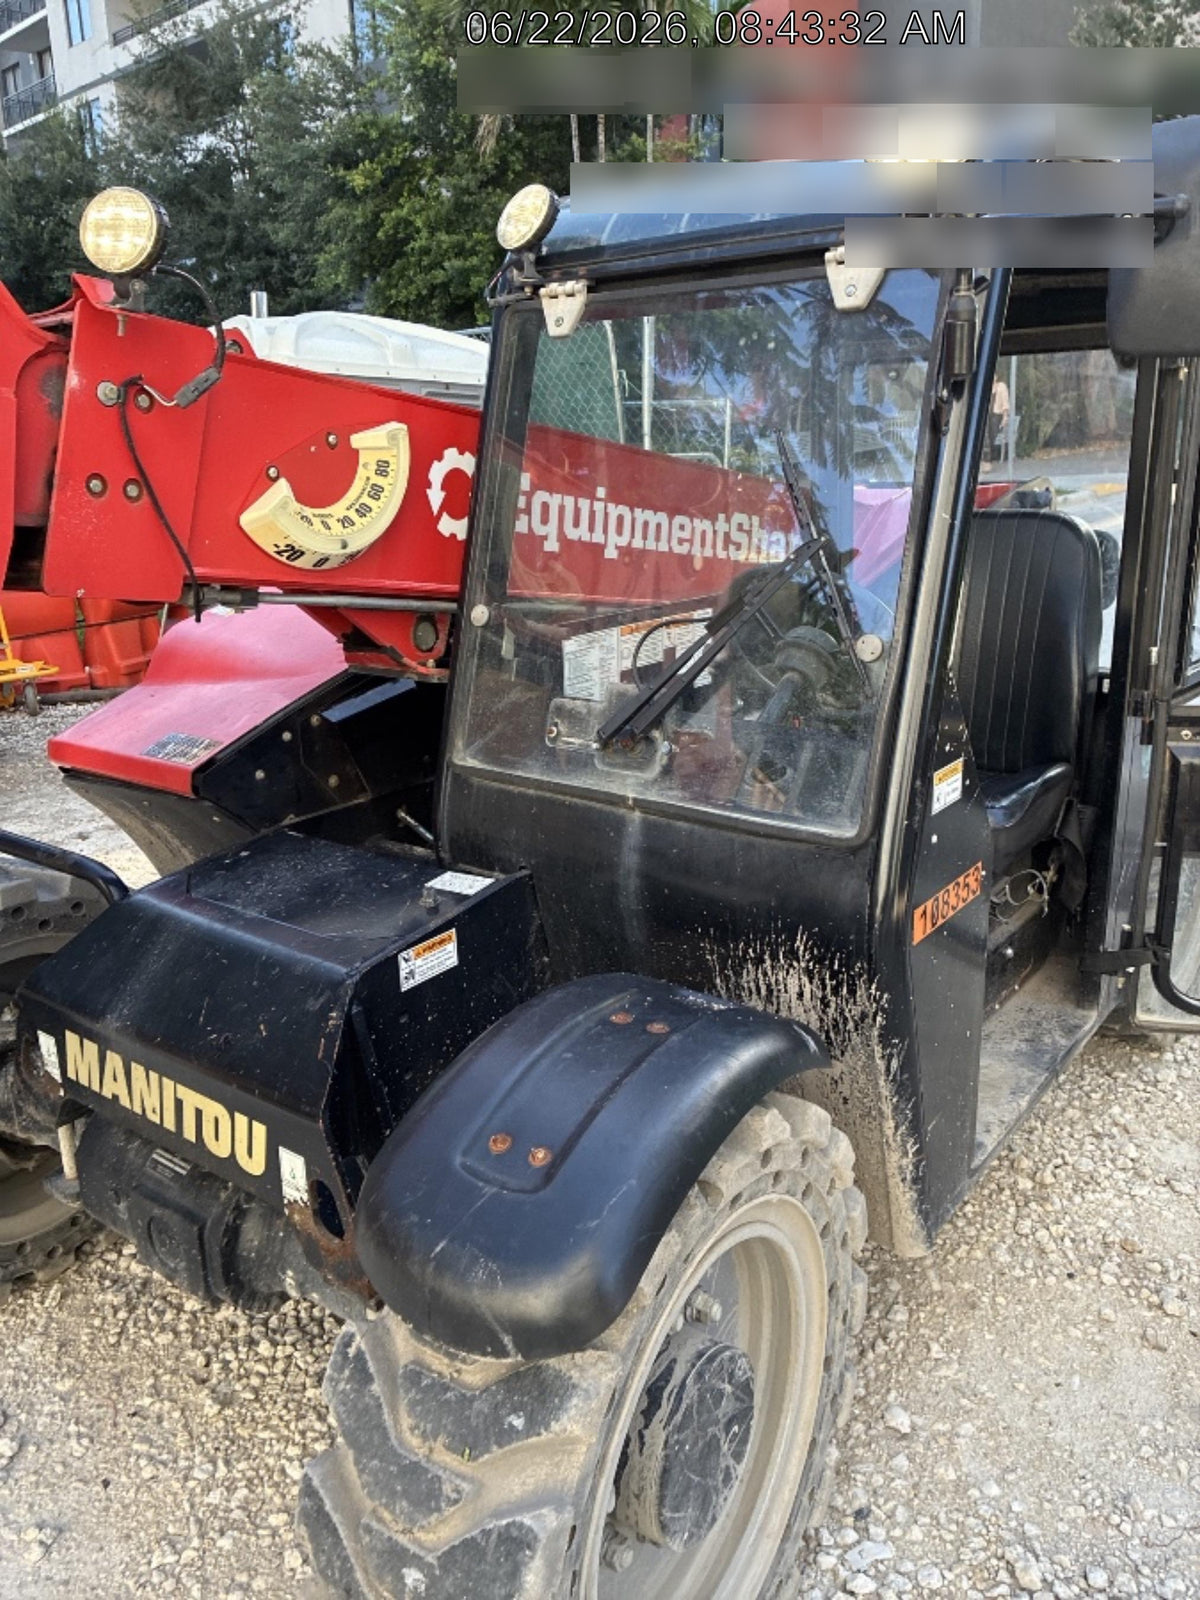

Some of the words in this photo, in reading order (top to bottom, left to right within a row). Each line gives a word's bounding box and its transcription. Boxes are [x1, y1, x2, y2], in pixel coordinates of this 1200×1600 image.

[375, 460, 391, 478] 80
[367, 483, 385, 501] 60
[355, 503, 373, 519] 40
[337, 515, 355, 529] 20
[273, 543, 306, 562] -20
[312, 556, 330, 568] 0
[920, 866, 980, 936] 108353
[64, 1028, 268, 1177] MANITOU
